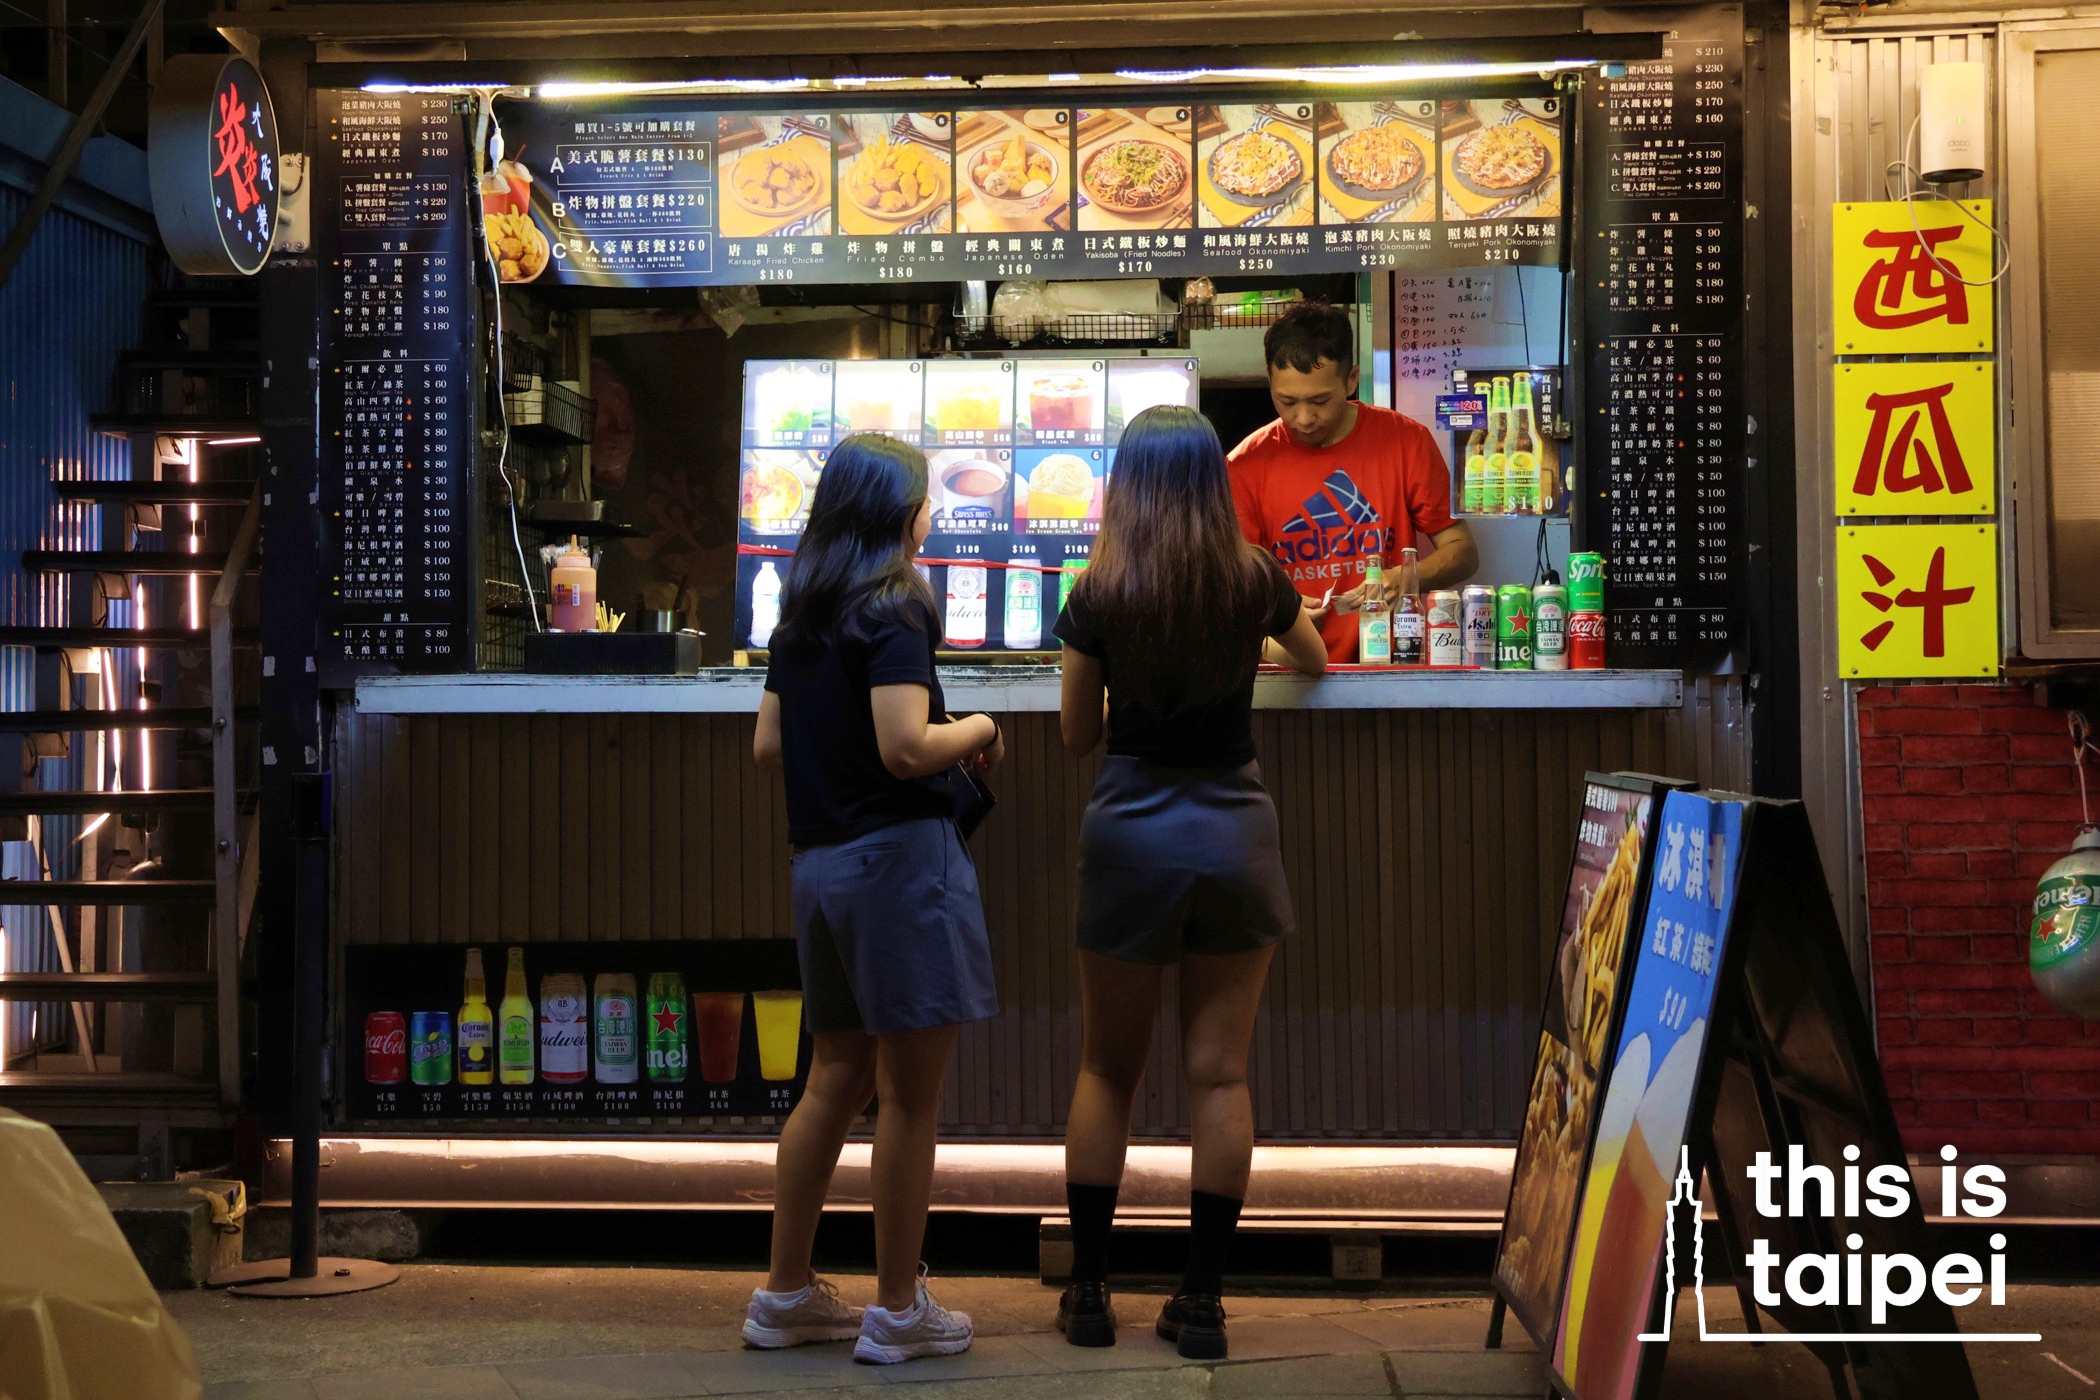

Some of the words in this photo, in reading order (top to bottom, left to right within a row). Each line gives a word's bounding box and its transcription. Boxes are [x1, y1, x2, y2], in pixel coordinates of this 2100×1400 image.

[550, 157, 565, 174] A
[552, 203, 566, 218] B
[1324, 228, 1432, 244] 泡菜豬肉大阪燒
[1447, 224, 1557, 241] 照燒豬肉大阪燒
[965, 238, 1065, 253] 經典關東煮
[1084, 235, 1187, 250] 日式鐵板炒麵
[1203, 232, 1310, 248] 和風海鮮大阪燒
[1448, 240, 1479, 249] Teriyaki
[1483, 239, 1501, 247] Pork
[1505, 237, 1556, 246] Okonomiyaki
[382, 242, 408, 251] 單點
[552, 242, 567, 259] C
[728, 242, 824, 256] 唐揚炸雞
[847, 240, 944, 255] 炸物拼盤
[1203, 248, 1242, 257] Seafood
[1249, 247, 1310, 256] Okonomiyaki
[1325, 245, 1352, 253] Kimchi
[1356, 244, 1375, 252] Pork
[1379, 242, 1432, 251] Okonomiyaki
[847, 255, 886, 263] Fried
[899, 254, 945, 263] Combo
[964, 253, 1024, 262] Japanese
[1033, 252, 1064, 260] Oden
[1084, 251, 1119, 259] Yakisoba
[1123, 250, 1147, 259] (Fried
[1151, 250, 1186, 258] Noodles)
[1360, 254, 1395, 266] $230
[1484, 249, 1520, 261] $210
[728, 257, 762, 266] Karaage
[766, 256, 787, 265] Fried
[791, 256, 824, 264] Chicken
[1118, 261, 1152, 273] $170
[1239, 258, 1273, 270] $250
[759, 268, 794, 281] $180
[879, 266, 913, 279] $180
[998, 263, 1032, 275] $160
[811, 434, 829, 443] $80
[993, 433, 1011, 443] $60
[1084, 433, 1102, 442] $60
[1854, 225, 1975, 657] 西瓜汁
[1508, 495, 1553, 510] $150
[991, 522, 1009, 532] $60
[1083, 522, 1100, 532] $90
[955, 544, 980, 554] $100
[1012, 544, 1037, 554] $100
[1064, 544, 1089, 554] $100
[1271, 526, 1396, 565] adidas
[1568, 559, 1608, 583] Spri
